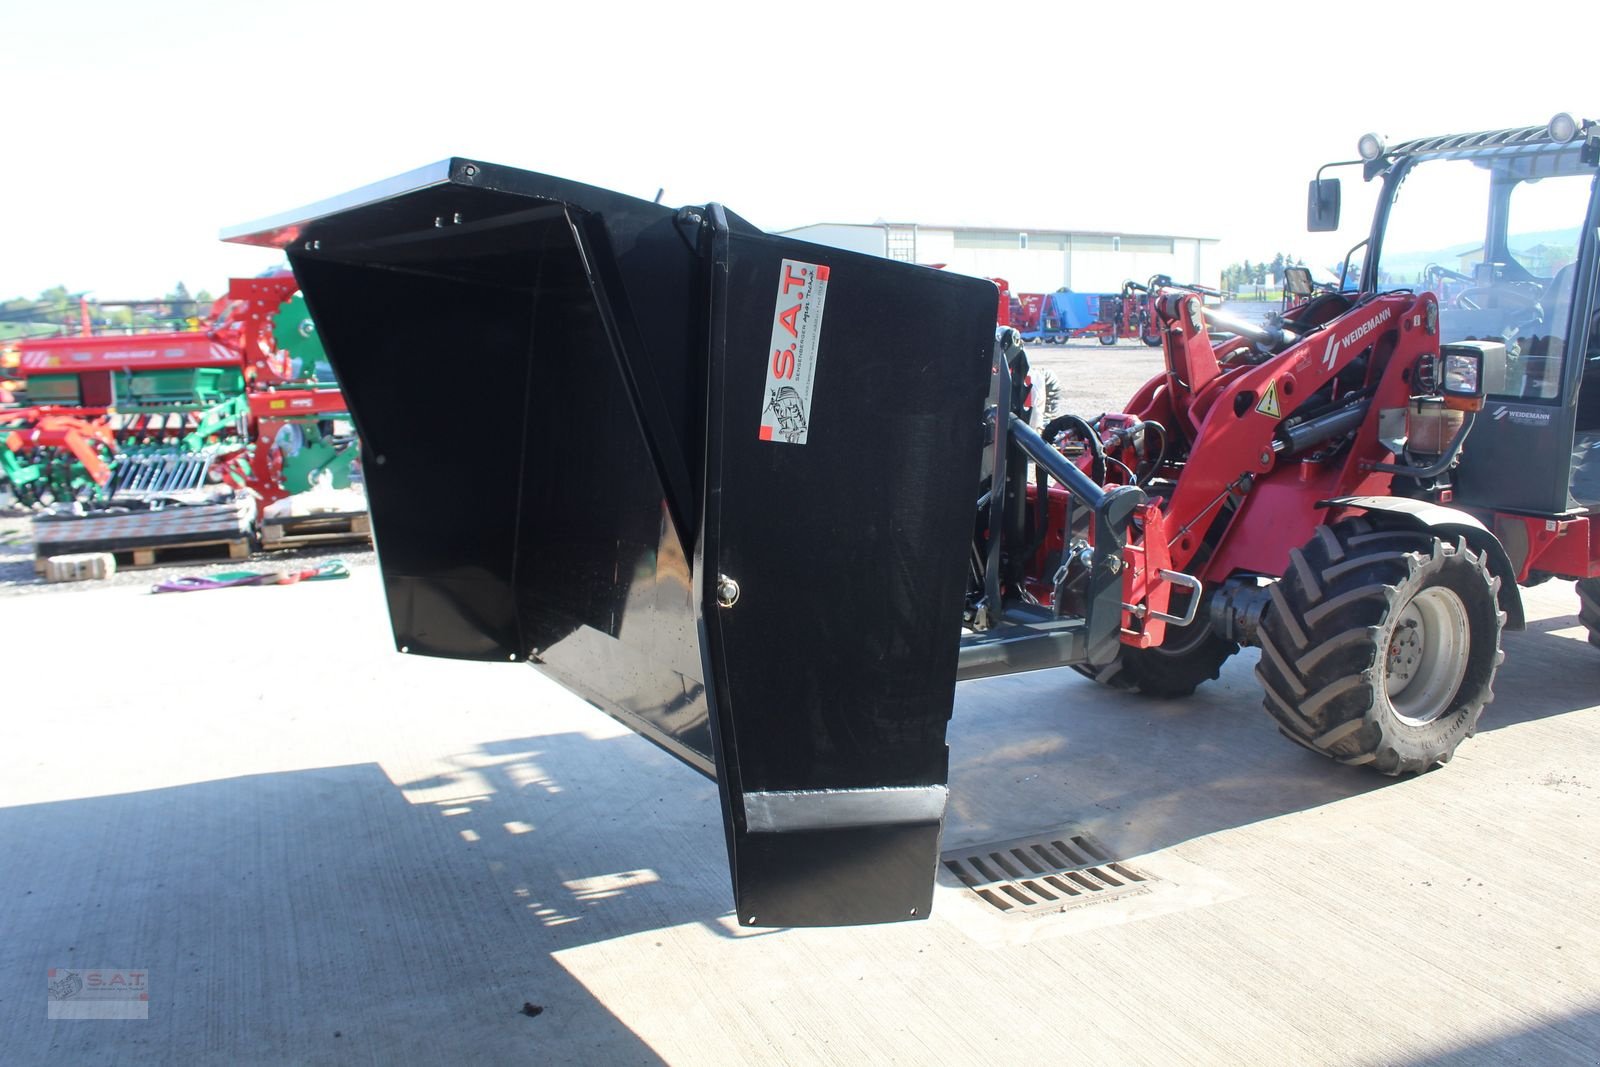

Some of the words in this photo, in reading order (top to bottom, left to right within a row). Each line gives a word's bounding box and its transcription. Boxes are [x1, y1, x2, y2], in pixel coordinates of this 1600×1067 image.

[772, 265, 807, 380] S.A.T.
[1341, 307, 1392, 348] WEIDEMANN
[1509, 410, 1550, 420] WEIDEMANN
